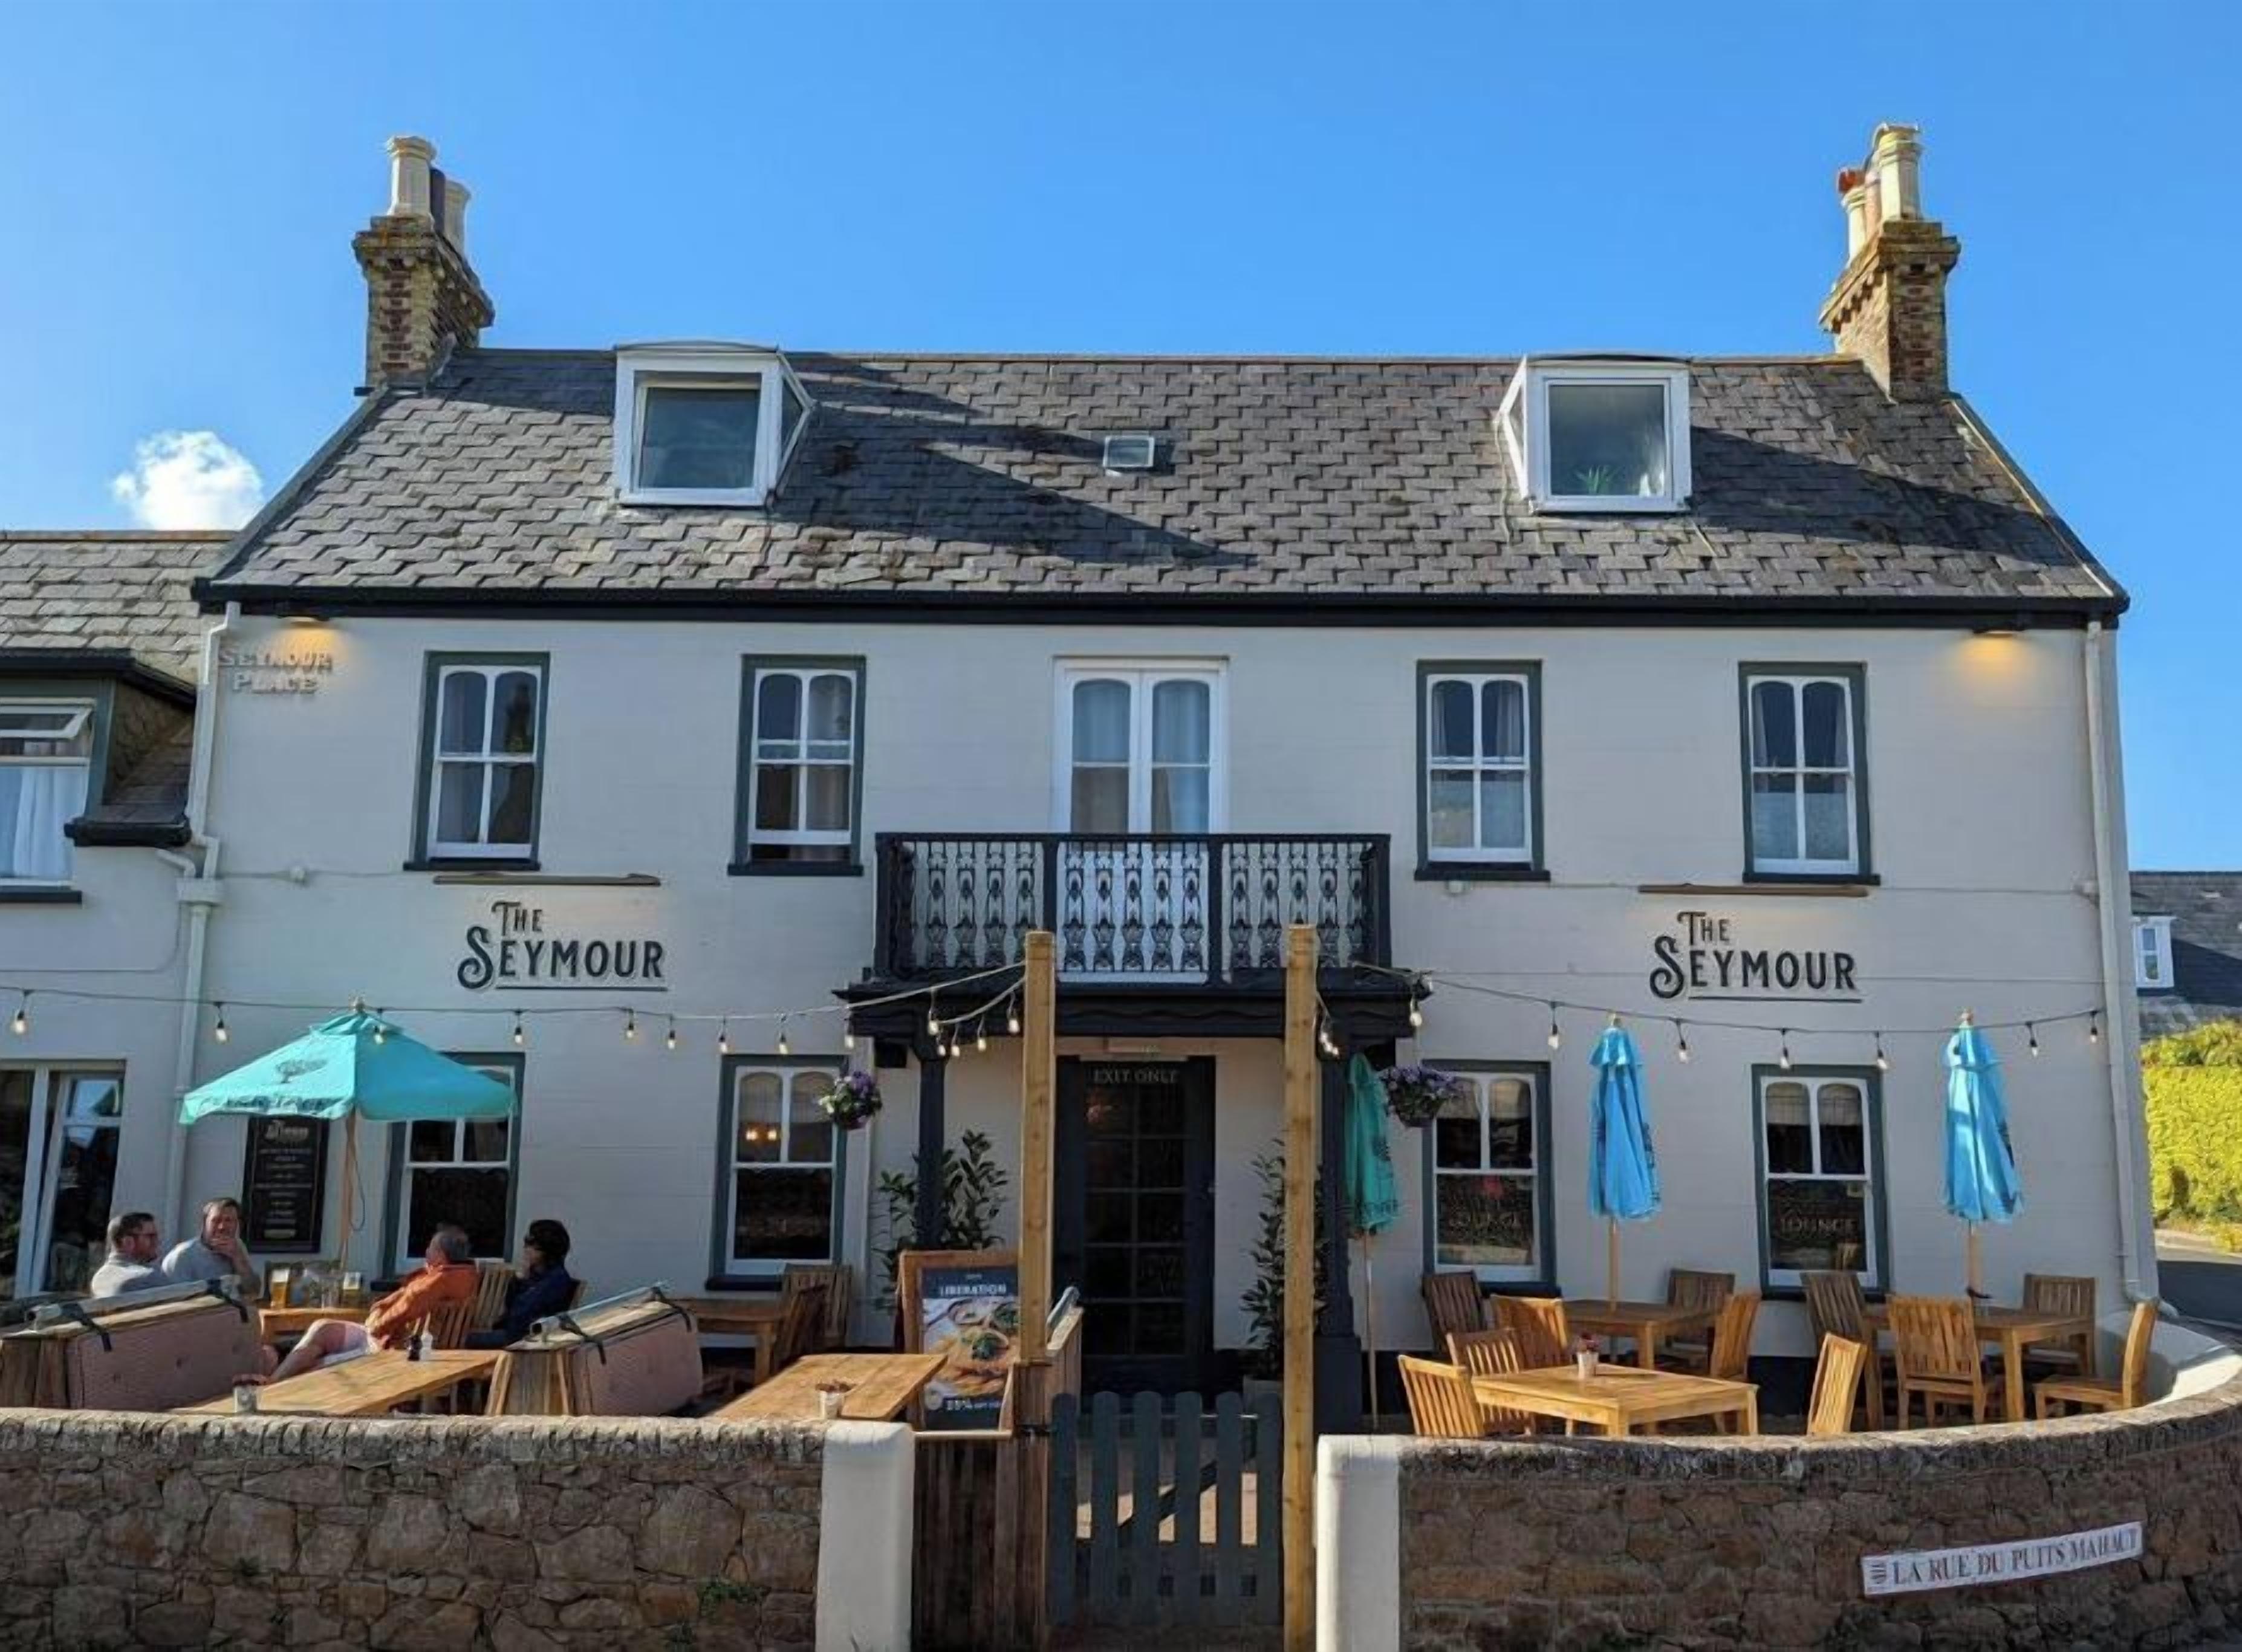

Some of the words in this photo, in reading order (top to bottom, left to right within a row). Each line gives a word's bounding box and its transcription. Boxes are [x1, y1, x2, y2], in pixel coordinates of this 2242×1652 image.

[491, 900, 544, 937] THE
[1677, 911, 1730, 946] THE
[457, 925, 664, 990] SEYMOUR
[1649, 935, 1856, 1000] SEYMOUR
[1093, 1068, 1129, 1084] EXIT
[1893, 1558, 1923, 1584] LA
[1928, 1554, 1971, 1582] RUE
[1977, 1551, 2005, 1575] DU
